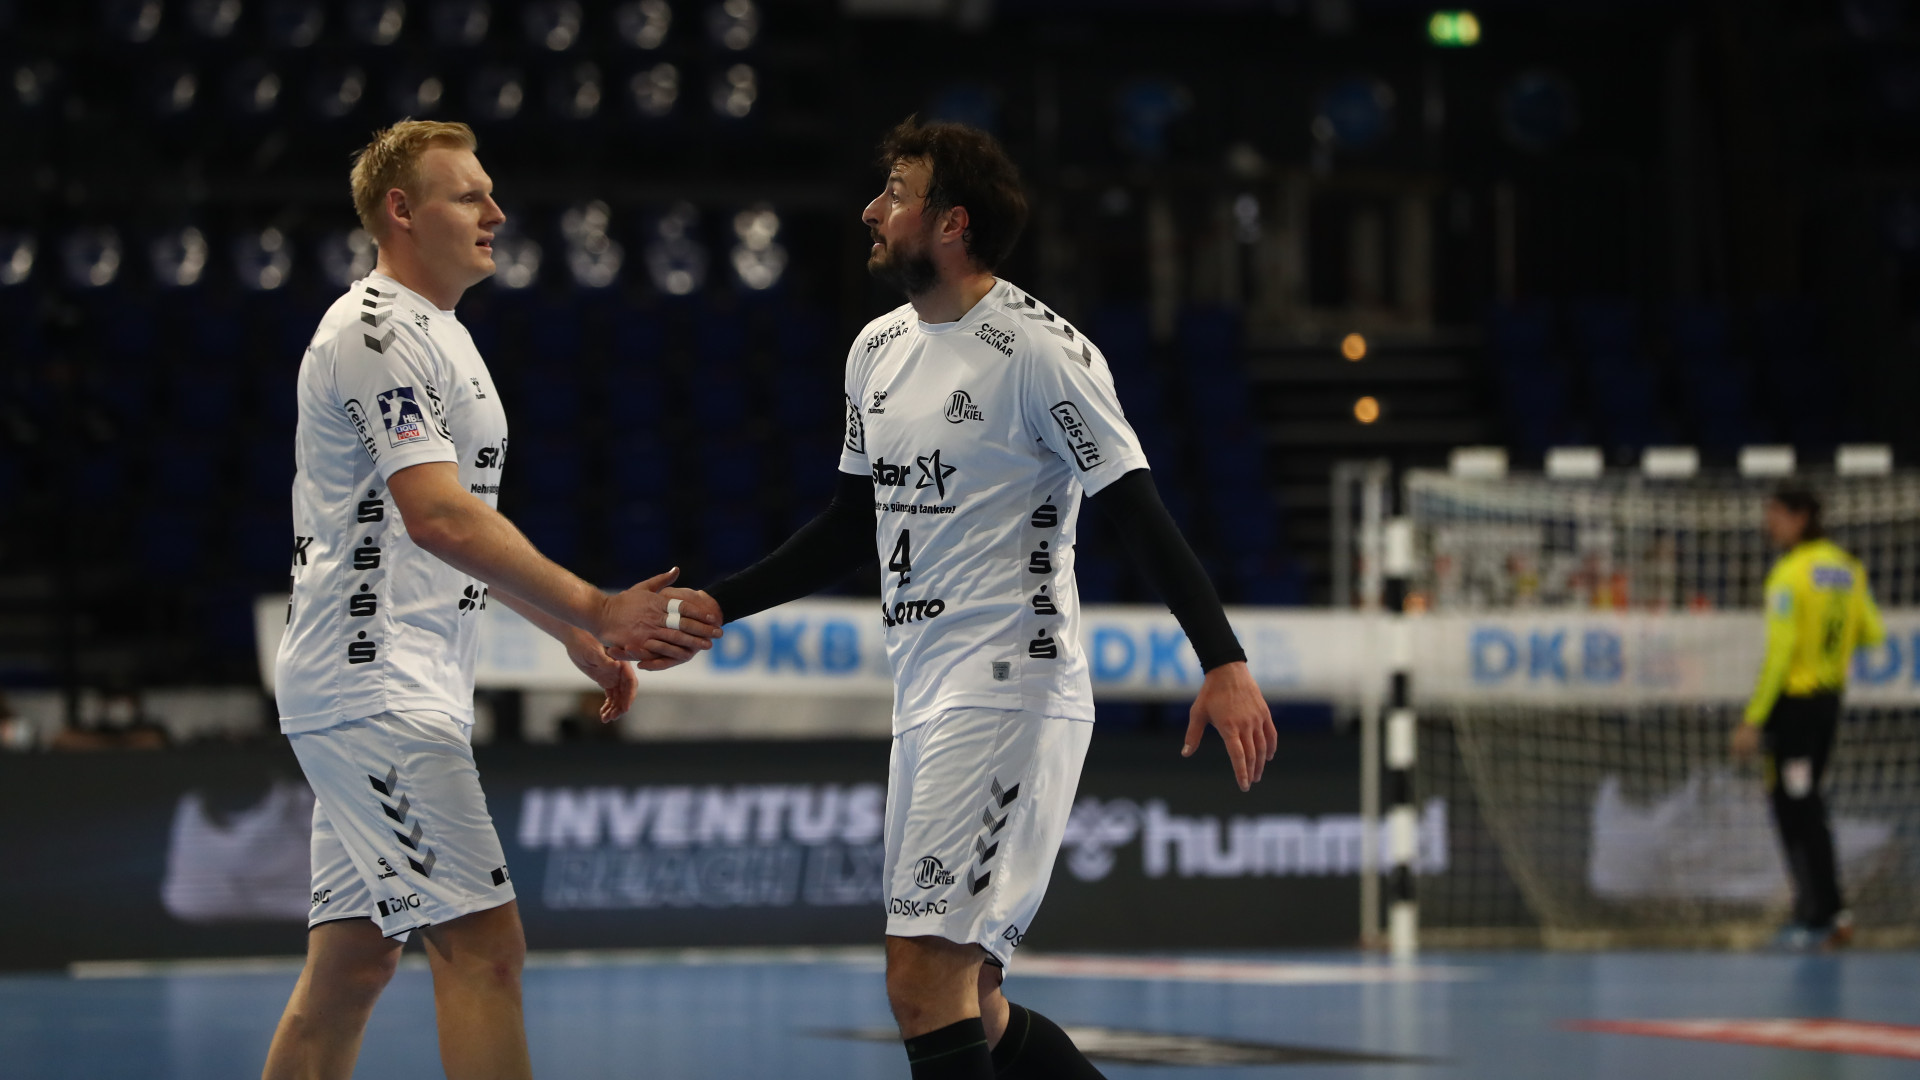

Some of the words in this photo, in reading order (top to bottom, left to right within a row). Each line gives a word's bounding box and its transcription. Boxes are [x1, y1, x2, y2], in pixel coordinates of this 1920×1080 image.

[975, 330, 1014, 358] CULINAR
[347, 405, 378, 457] reis-fit
[403, 413, 423, 424] HBL
[963, 410, 985, 422] KIEL
[1058, 407, 1100, 463] reis-fit
[919, 504, 957, 514] tanken!
[889, 529, 912, 588] 4
[710, 620, 862, 673] DKB
[1090, 625, 1203, 684] DK
[1468, 628, 1626, 684] DKB
[516, 783, 886, 847] INVENTUS
[1142, 798, 1449, 878] humml
[934, 875, 956, 885] KIEL
